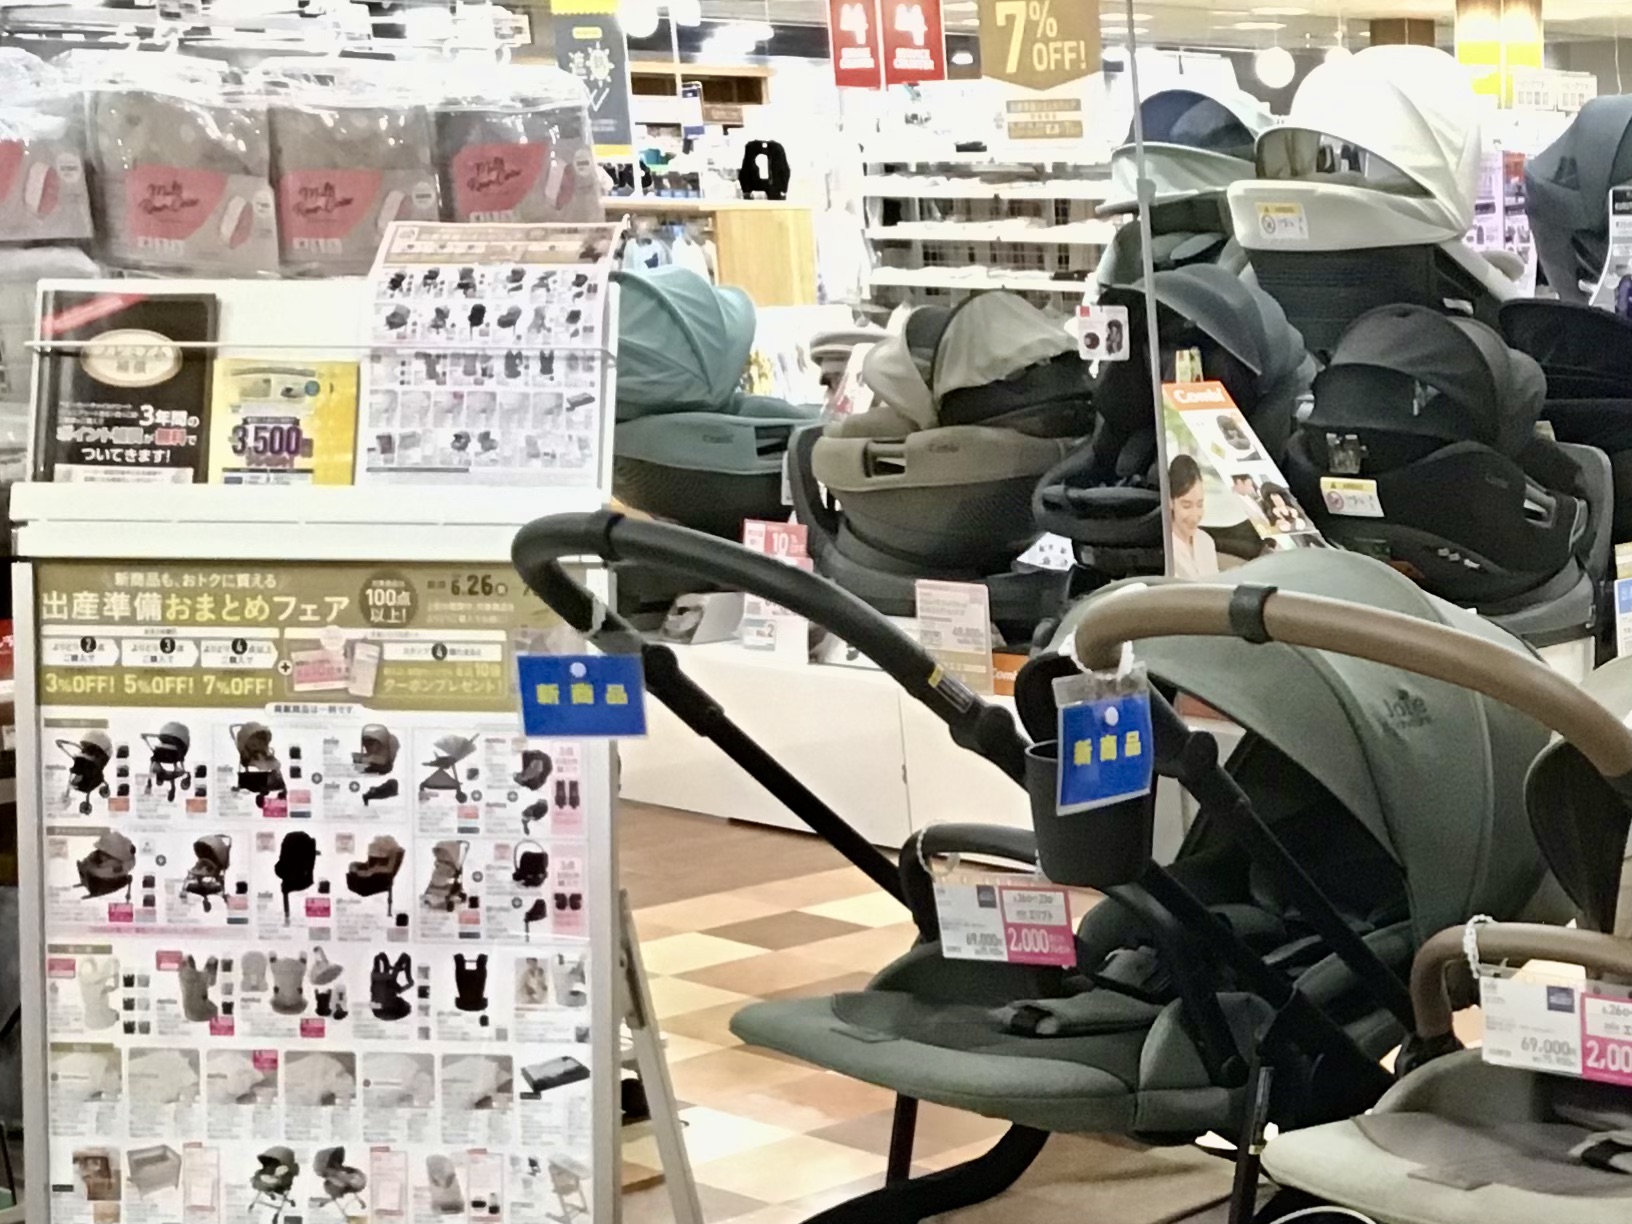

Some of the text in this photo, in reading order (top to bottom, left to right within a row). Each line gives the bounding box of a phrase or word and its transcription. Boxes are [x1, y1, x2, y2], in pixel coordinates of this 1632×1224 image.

[1033, 40, 1087, 72] OFF!
[81, 448, 171, 464] ついてきます!
[42, 590, 350, 623] 出産準備おまとめフェア
[370, 607, 407, 624] 以上!
